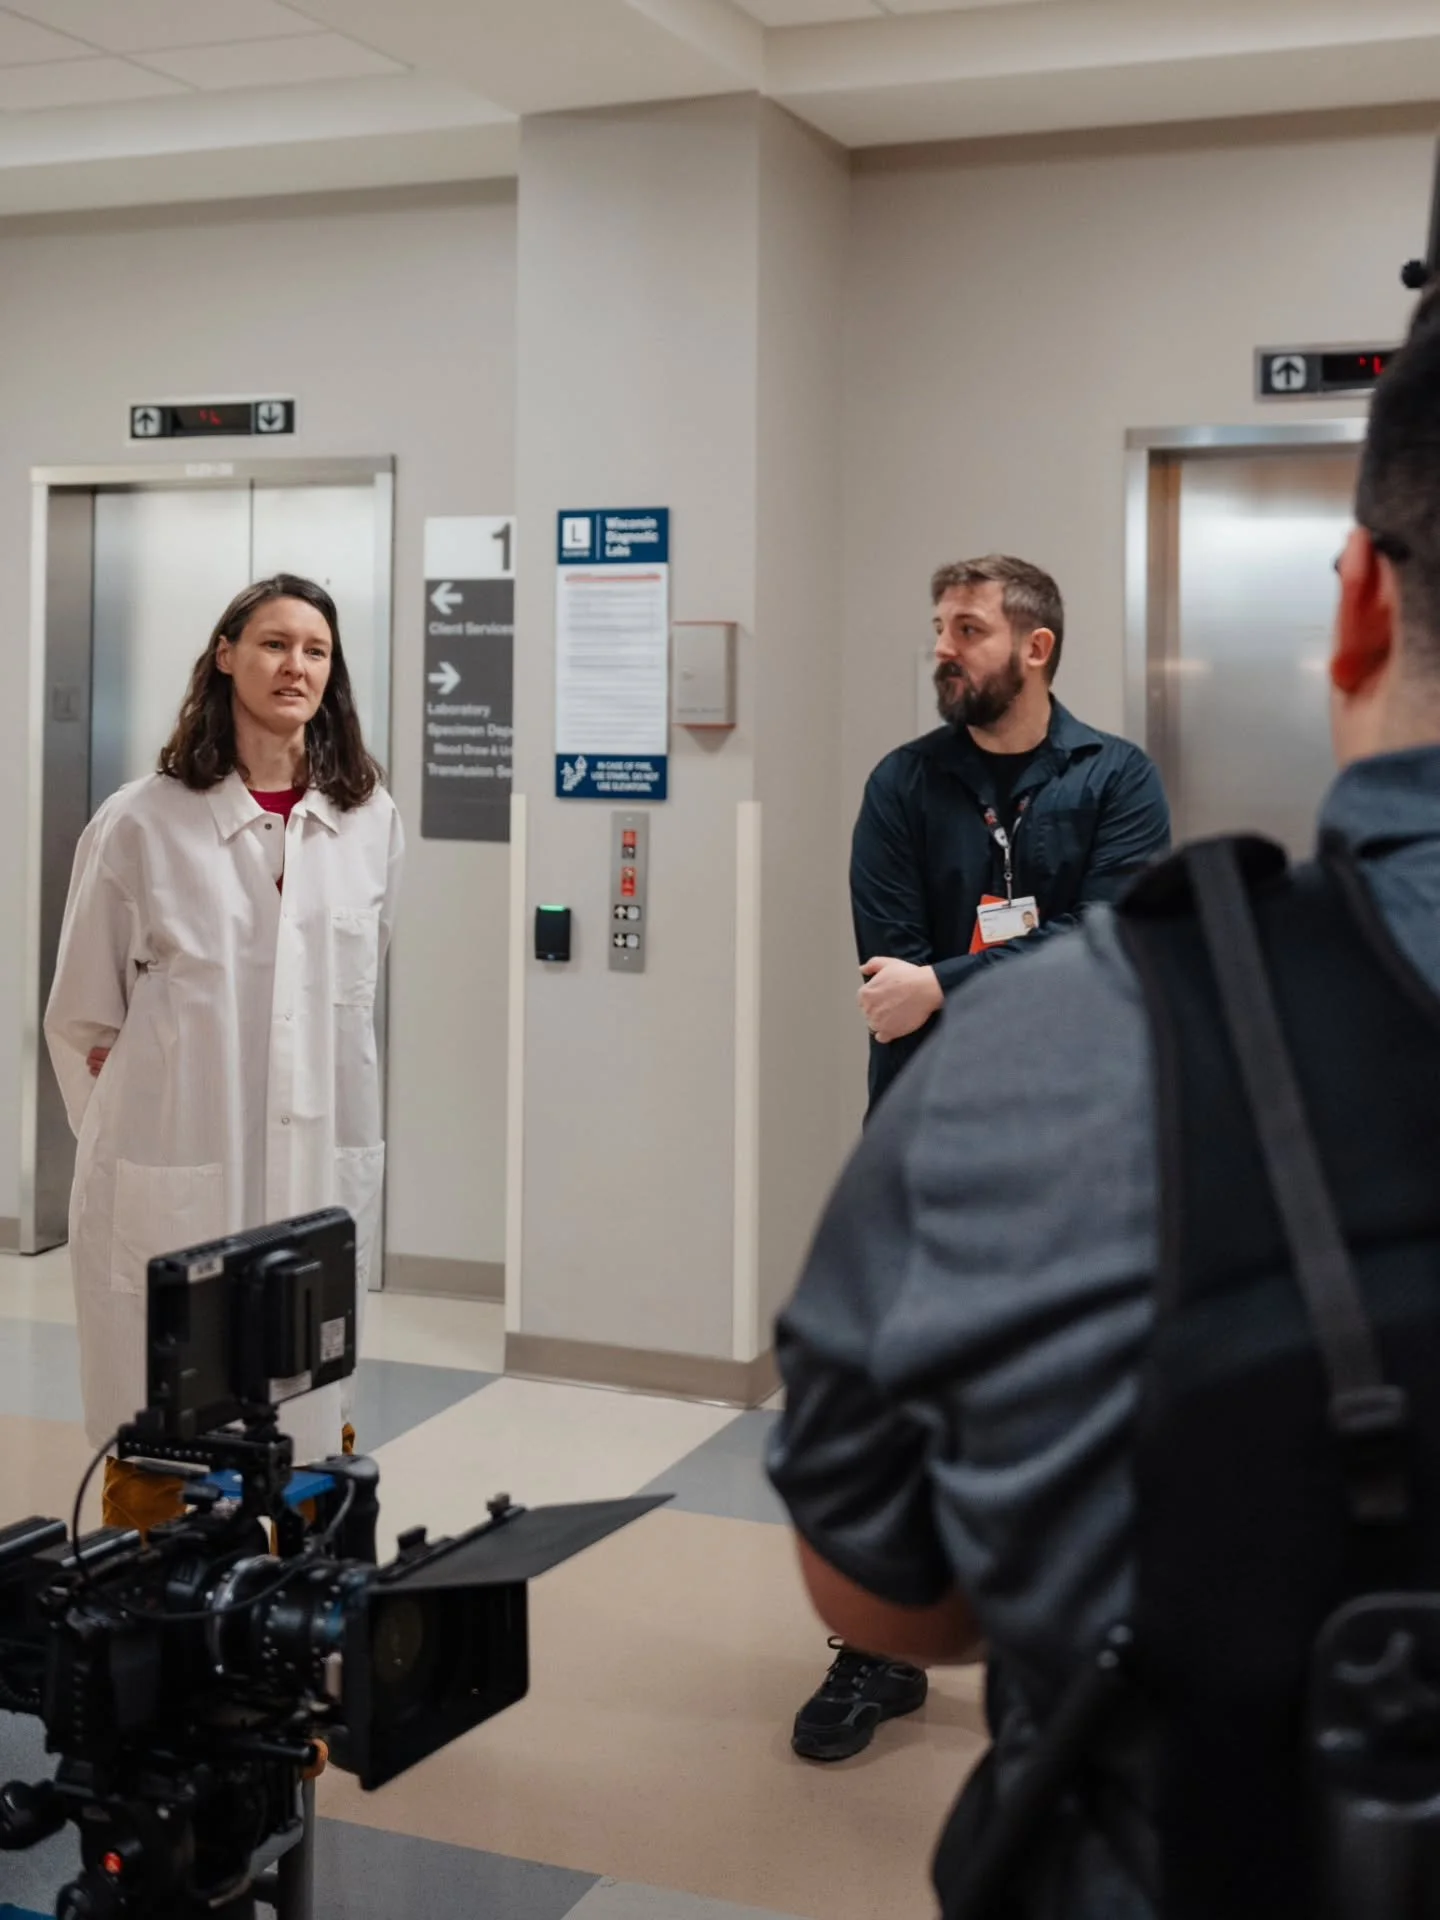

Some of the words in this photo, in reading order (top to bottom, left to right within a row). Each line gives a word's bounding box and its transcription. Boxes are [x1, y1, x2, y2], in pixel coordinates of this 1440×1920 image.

[605, 516, 657, 529] Wisconsin
[571, 523, 582, 542] L
[605, 530, 659, 544] Diagnostic
[492, 521, 511, 571] 1
[429, 621, 463, 635] Client
[427, 701, 490, 718] Laboratory
[427, 722, 485, 739] Specimen
[427, 762, 494, 777] Transfusion
